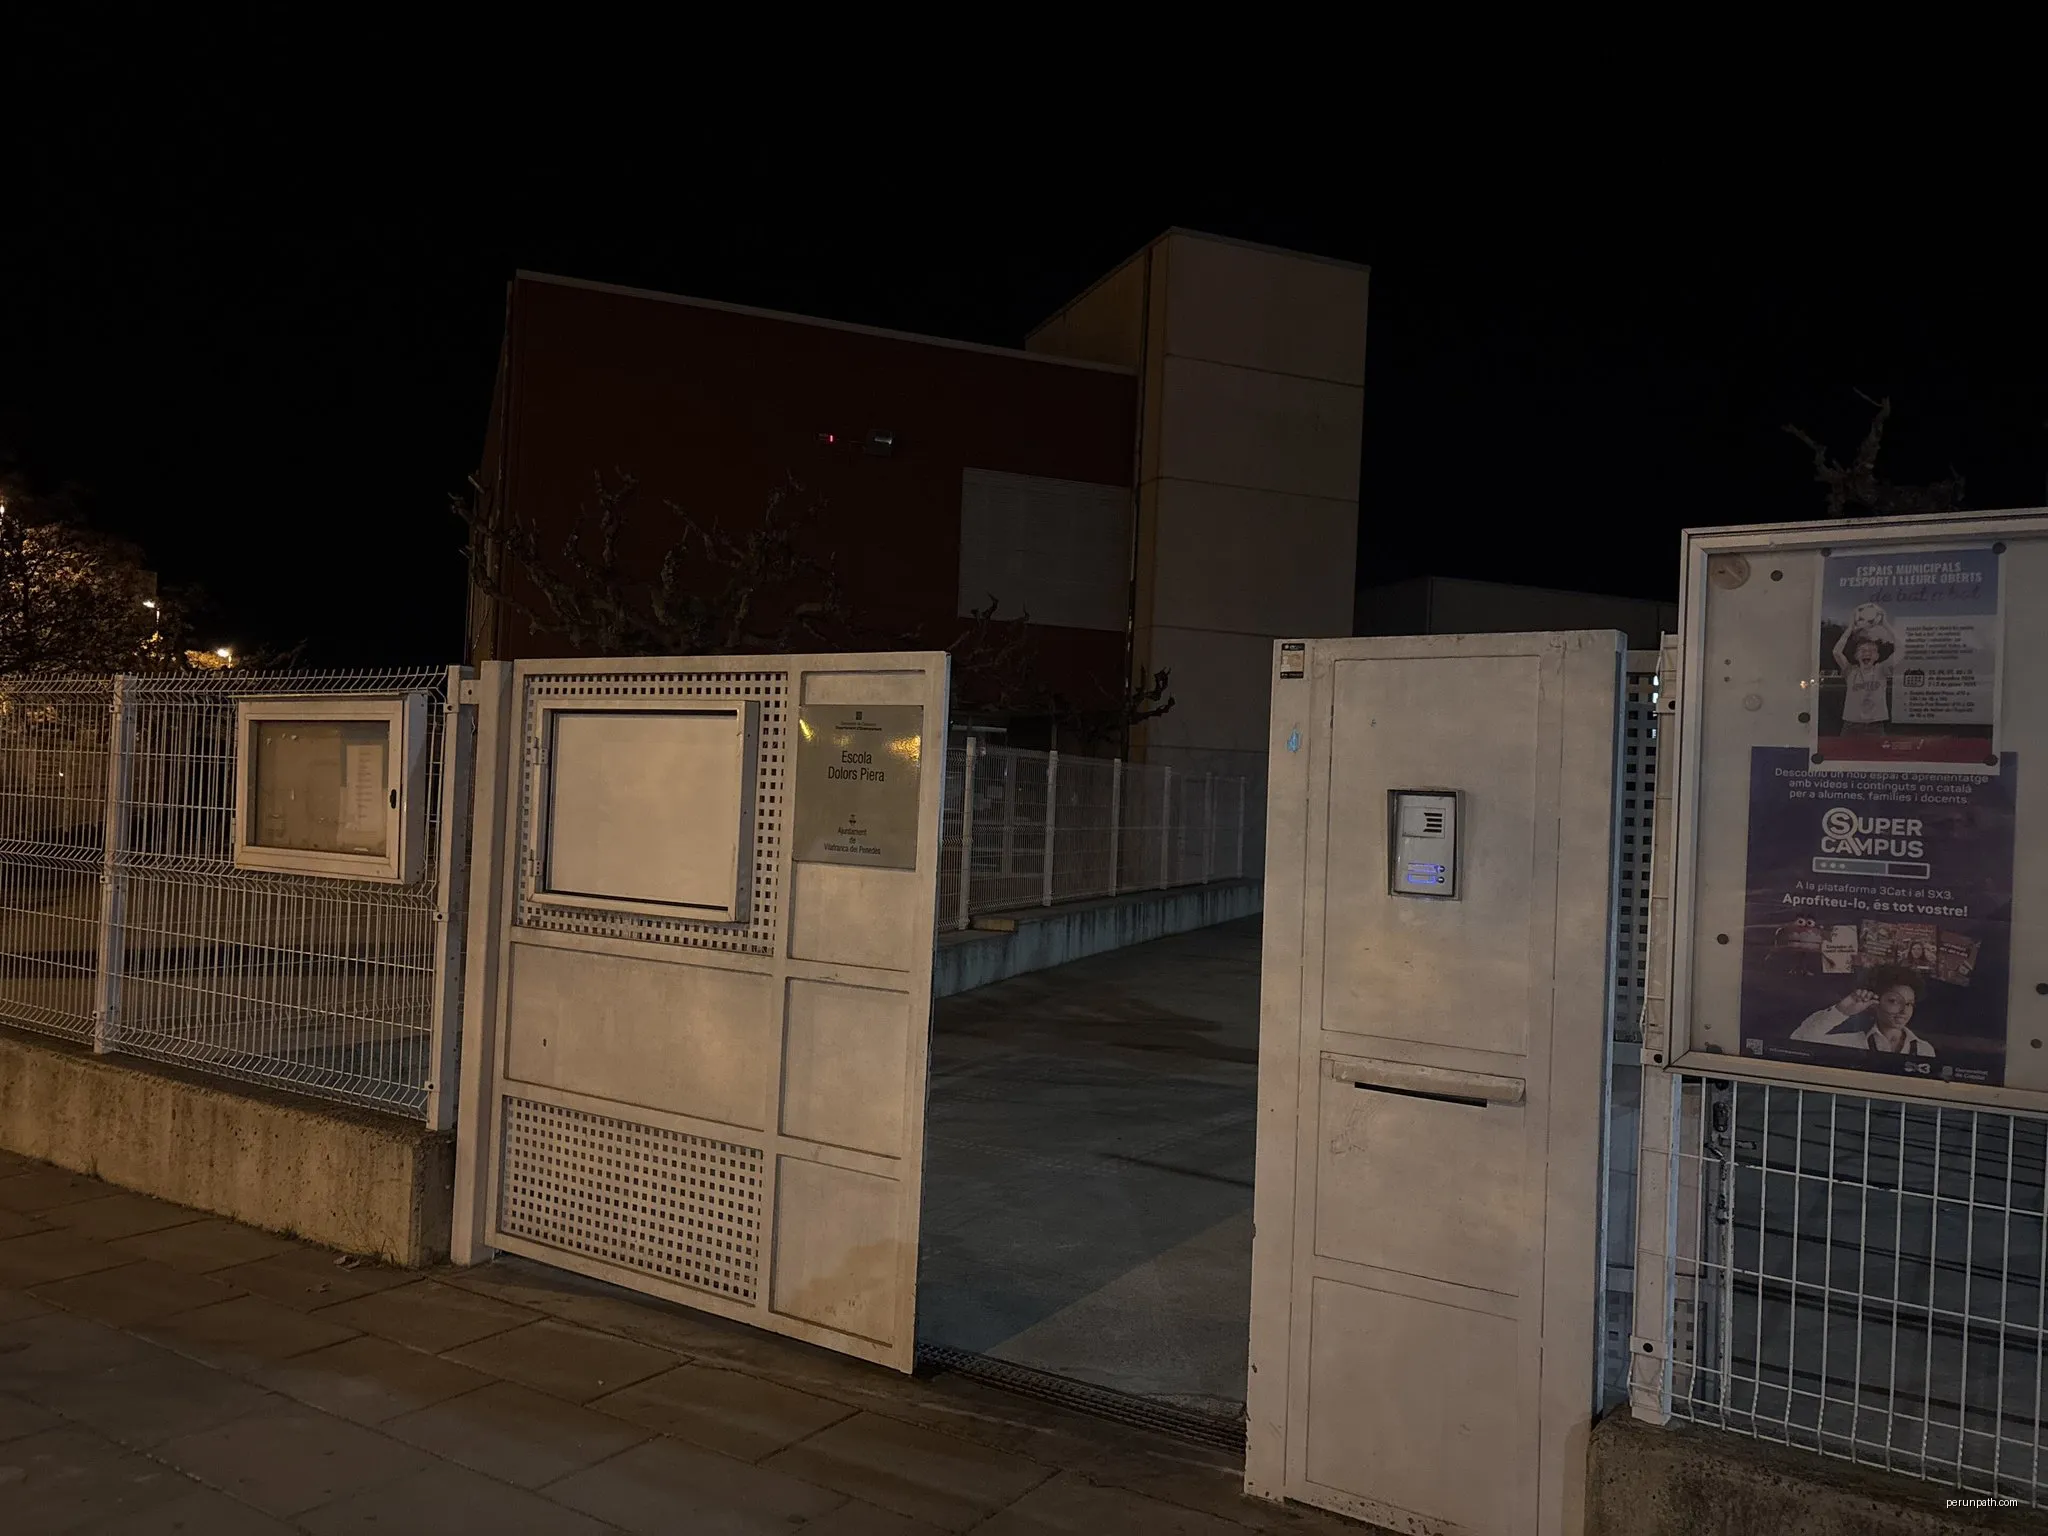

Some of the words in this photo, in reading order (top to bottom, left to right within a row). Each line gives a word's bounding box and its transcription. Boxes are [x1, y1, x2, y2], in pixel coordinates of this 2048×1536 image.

[1856, 565, 1893, 577] ESPAIS
[1896, 562, 1962, 575] MUNICIPALS
[1839, 576, 1889, 587] D'ESPORT
[1892, 576, 1896, 586] I
[1899, 574, 1938, 585] LLEURE
[1940, 572, 1983, 584] OBERTS
[841, 750, 872, 764] Escola
[828, 766, 857, 780] Dolors
[860, 767, 885, 782] Piera
[1789, 779, 1812, 788] amb
[1857, 781, 1916, 793] continguts
[1919, 784, 1934, 792] en
[1936, 784, 1972, 793] català
[1789, 790, 1806, 799] per
[1826, 809, 1923, 836] SUPER
[1821, 836, 1924, 858] CAMPUS
[1796, 881, 1803, 889] A
[1806, 881, 1815, 890] la
[1817, 883, 1877, 895] plataforma
[1879, 886, 1905, 897] 3Cat
[1782, 893, 1870, 911] Aprofiteu-lo,
[1873, 898, 1890, 911] és
[1893, 901, 1914, 913] tot
[1917, 904, 1968, 917] vostre!
